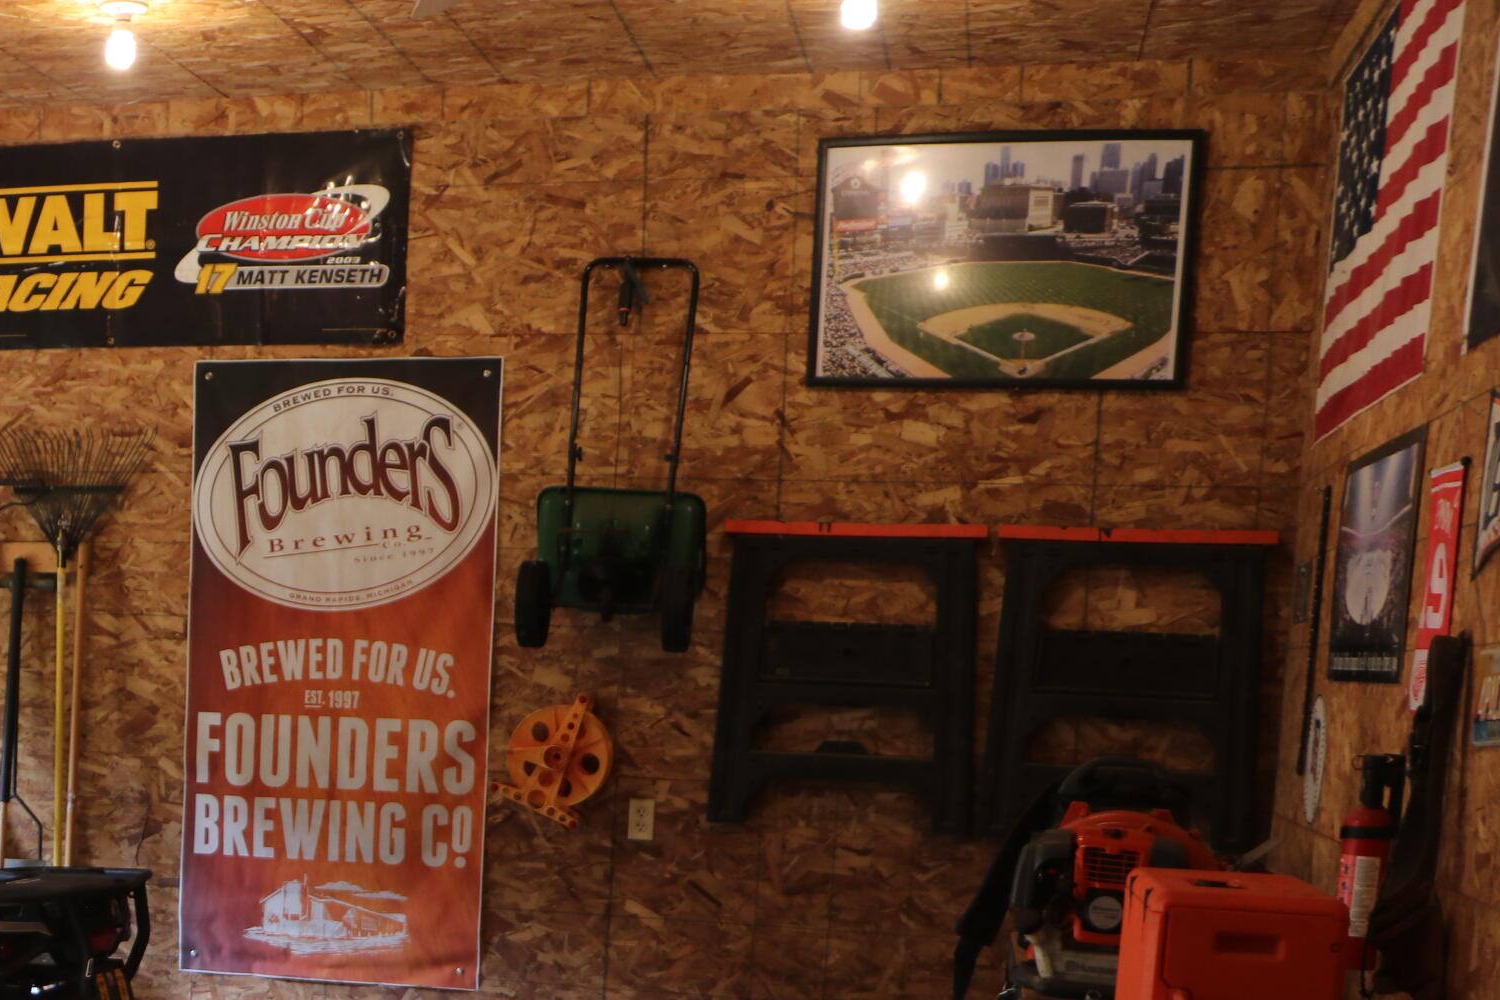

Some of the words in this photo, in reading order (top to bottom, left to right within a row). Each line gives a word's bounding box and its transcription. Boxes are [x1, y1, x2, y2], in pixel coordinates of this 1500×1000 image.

[223, 210, 302, 231] Winston
[304, 207, 347, 232] Cup
[197, 233, 367, 252] CHAMPION
[326, 256, 361, 265] 2003
[195, 263, 238, 294] 17
[236, 270, 289, 286] MATT
[294, 268, 383, 285] KENSETH
[273, 387, 332, 413] BREWED
[338, 386, 366, 395] FOR
[269, 525, 423, 553] Brewing
[220, 638, 344, 691] BREWED
[351, 638, 408, 687] FOR
[412, 648, 456, 699] US.
[304, 689, 326, 706] EST.
[328, 690, 360, 710] 1997
[195, 711, 476, 796] FOUNDERS
[193, 793, 408, 866] BREWING
